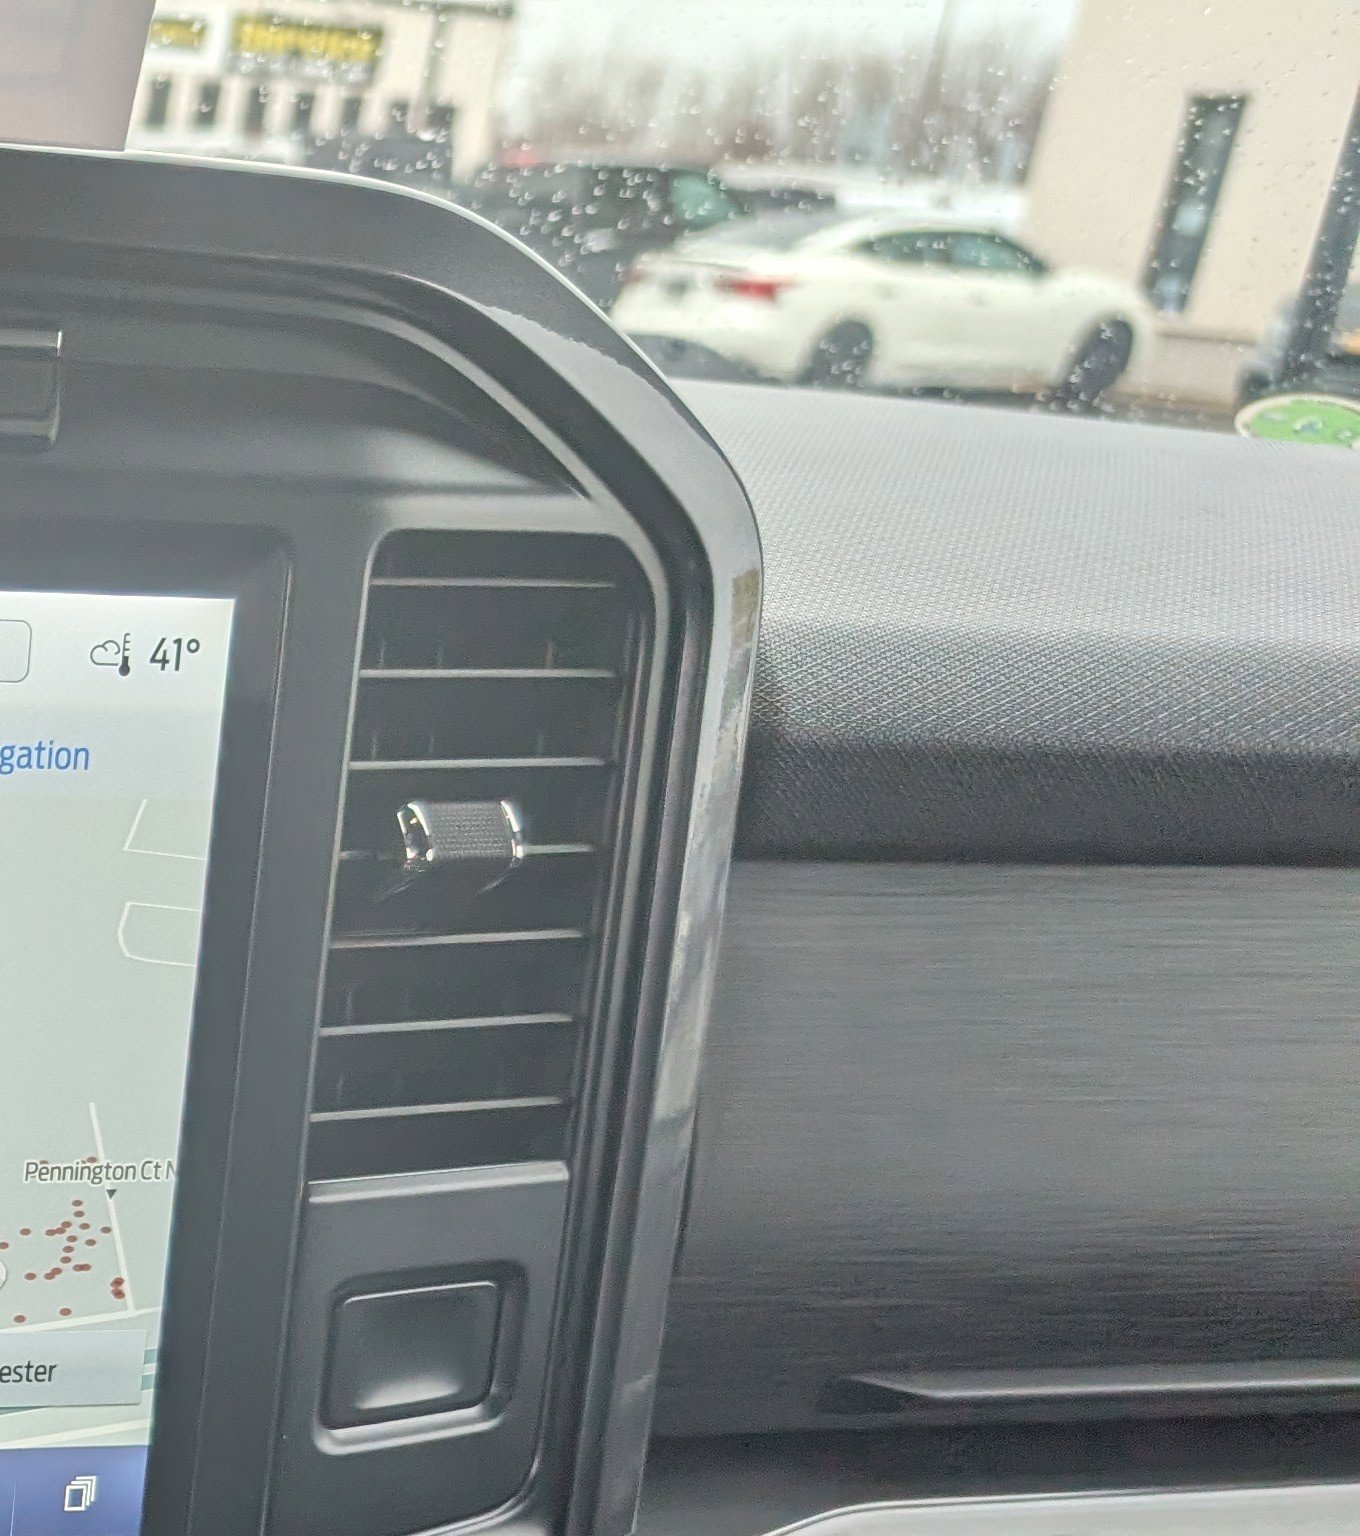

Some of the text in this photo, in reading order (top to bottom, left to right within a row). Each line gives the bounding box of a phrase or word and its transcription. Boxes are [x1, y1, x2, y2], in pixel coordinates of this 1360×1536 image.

[149, 637, 201, 672] 41°
[24, 1160, 137, 1184] Pennington
[140, 1160, 163, 1181] Ct
